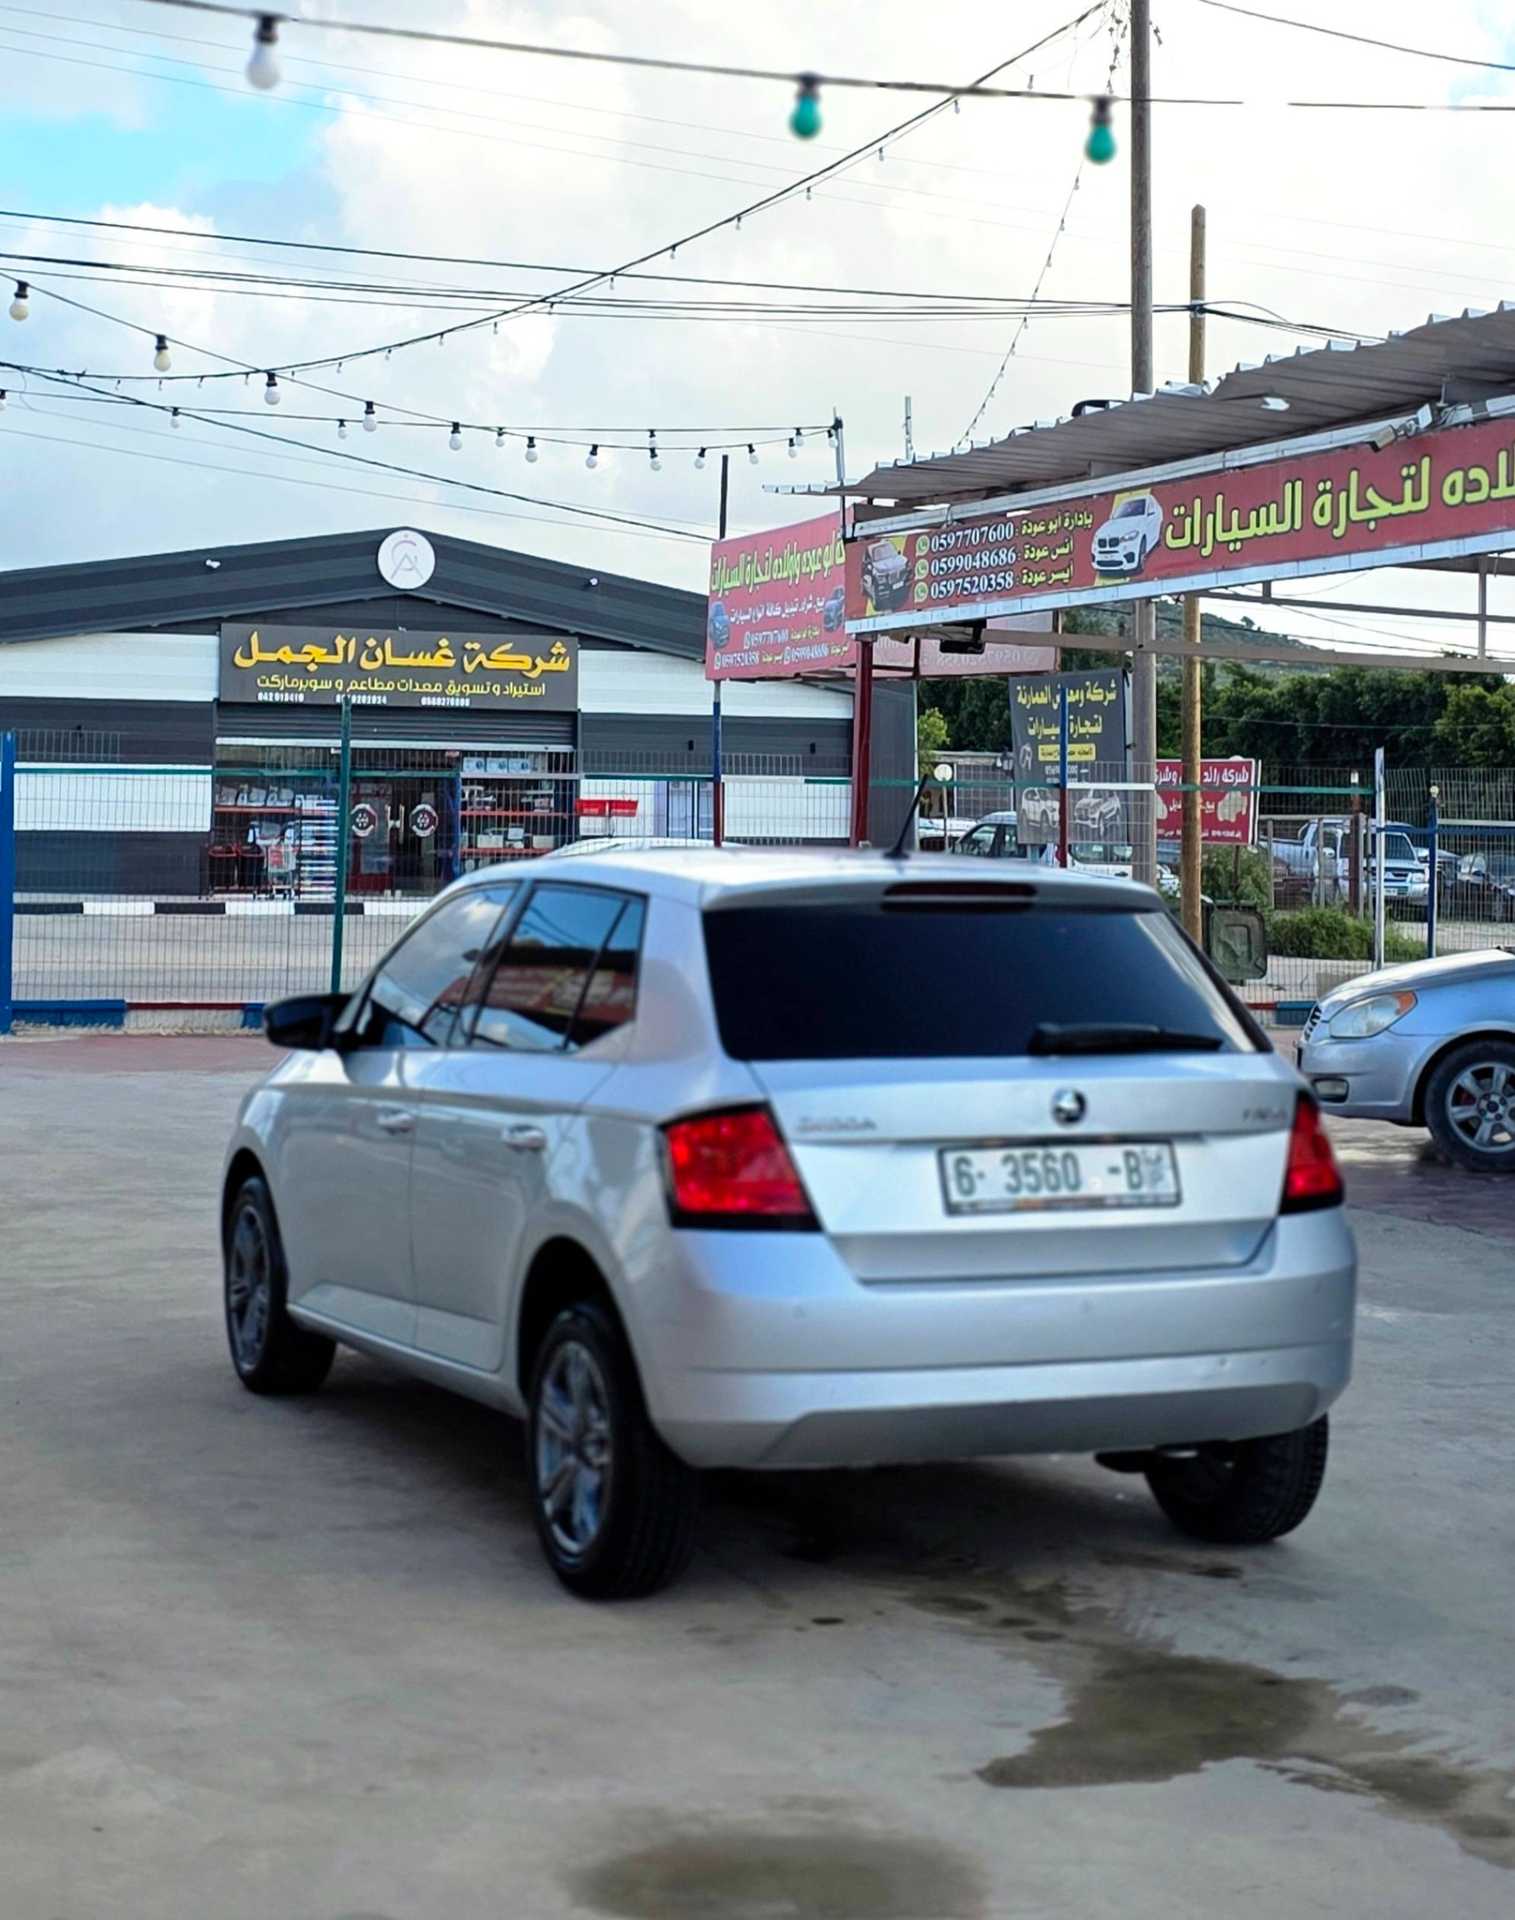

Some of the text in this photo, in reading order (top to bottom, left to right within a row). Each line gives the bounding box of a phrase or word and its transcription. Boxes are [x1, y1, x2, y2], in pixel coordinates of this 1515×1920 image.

[1312, 455, 1432, 538] لتجارة
[1021, 518, 1046, 537] عودة
[1165, 480, 1303, 557] السيارات
[930, 521, 1014, 552] 0597707600
[930, 546, 1016, 577] 0599048686
[1023, 543, 1050, 562] عودة
[930, 570, 1014, 600] 0597520358
[1021, 568, 1046, 587] عودة
[233, 630, 571, 678] شركة غسان الجمل
[256, 674, 333, 691] سوبرماركت
[335, 679, 345, 691] و
[346, 676, 396, 692] مطاعم
[397, 677, 443, 692] معدات
[502, 680, 546, 697] استيراد
[1086, 679, 1117, 706] شركة
[1069, 714, 1103, 739] لتجارة
[1001, 1150, 1082, 1194] 3560
